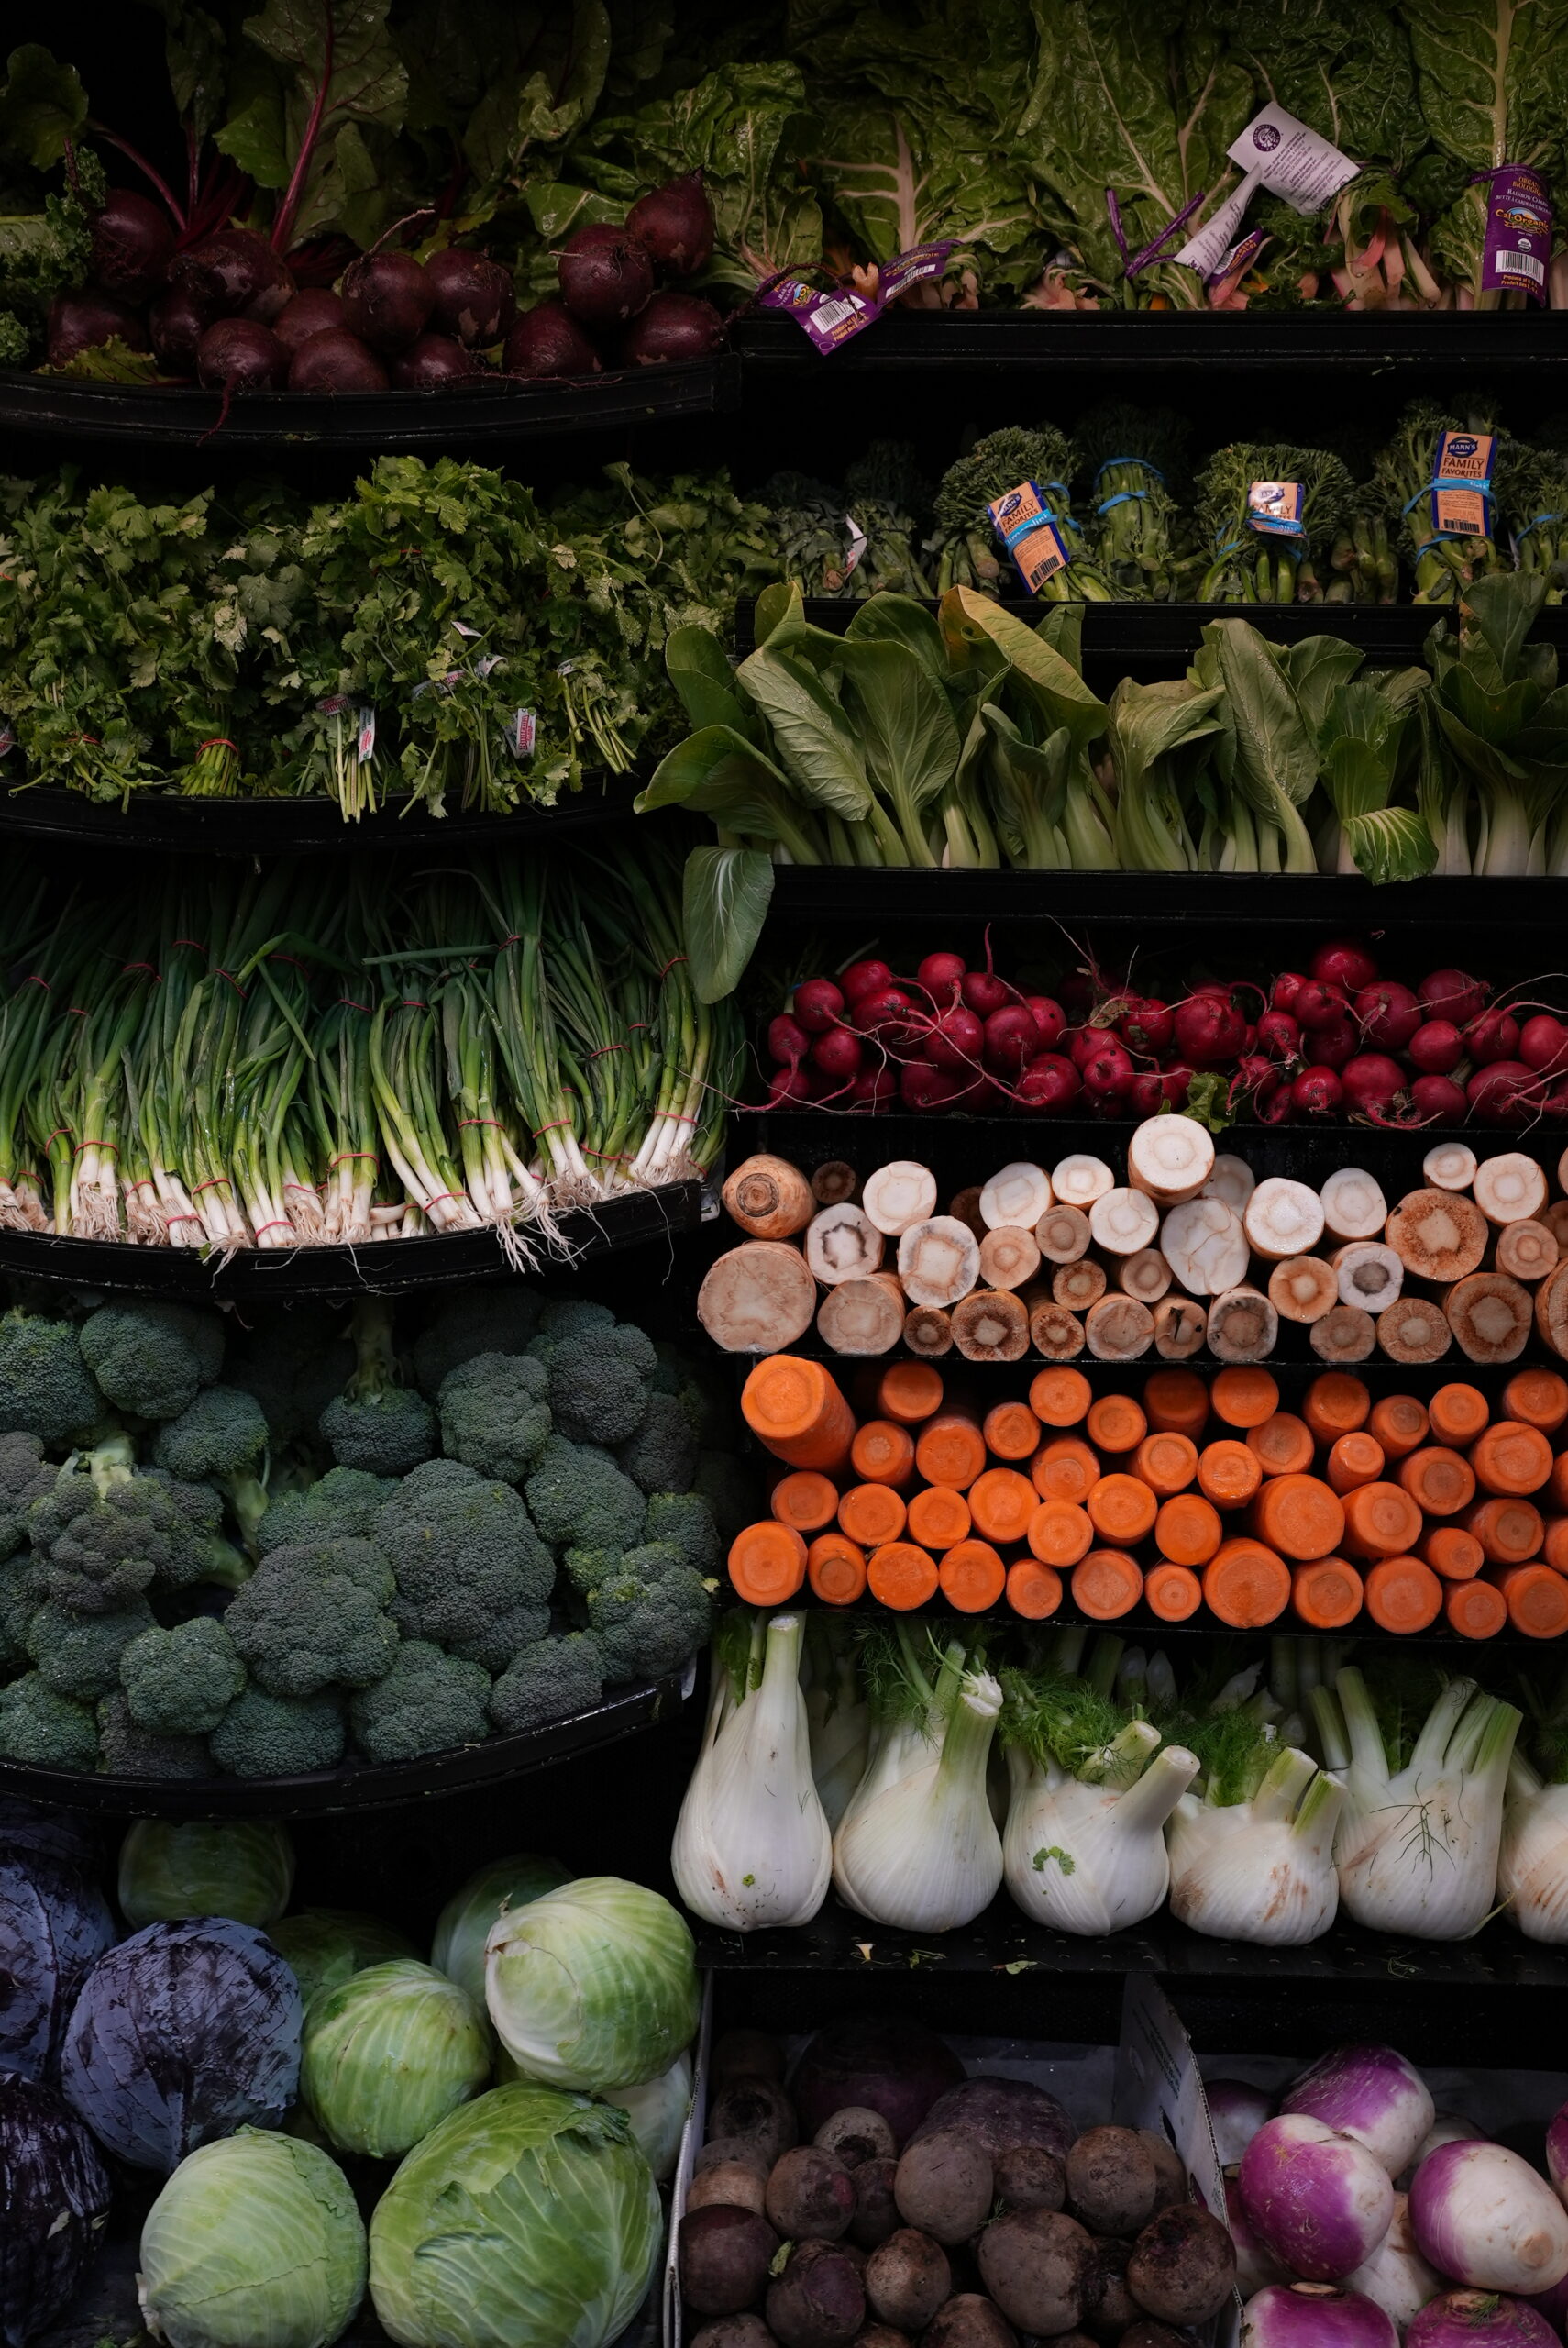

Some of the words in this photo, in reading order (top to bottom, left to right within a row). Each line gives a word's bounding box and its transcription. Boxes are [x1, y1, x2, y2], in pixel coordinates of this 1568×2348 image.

[1449, 442, 1476, 451] MANN'S
[1443, 457, 1484, 470] FAMILY
[1442, 468, 1482, 478] FAVORITES
[1001, 500, 1034, 527] FAMILY
[1005, 509, 1039, 533] FAVORITES
